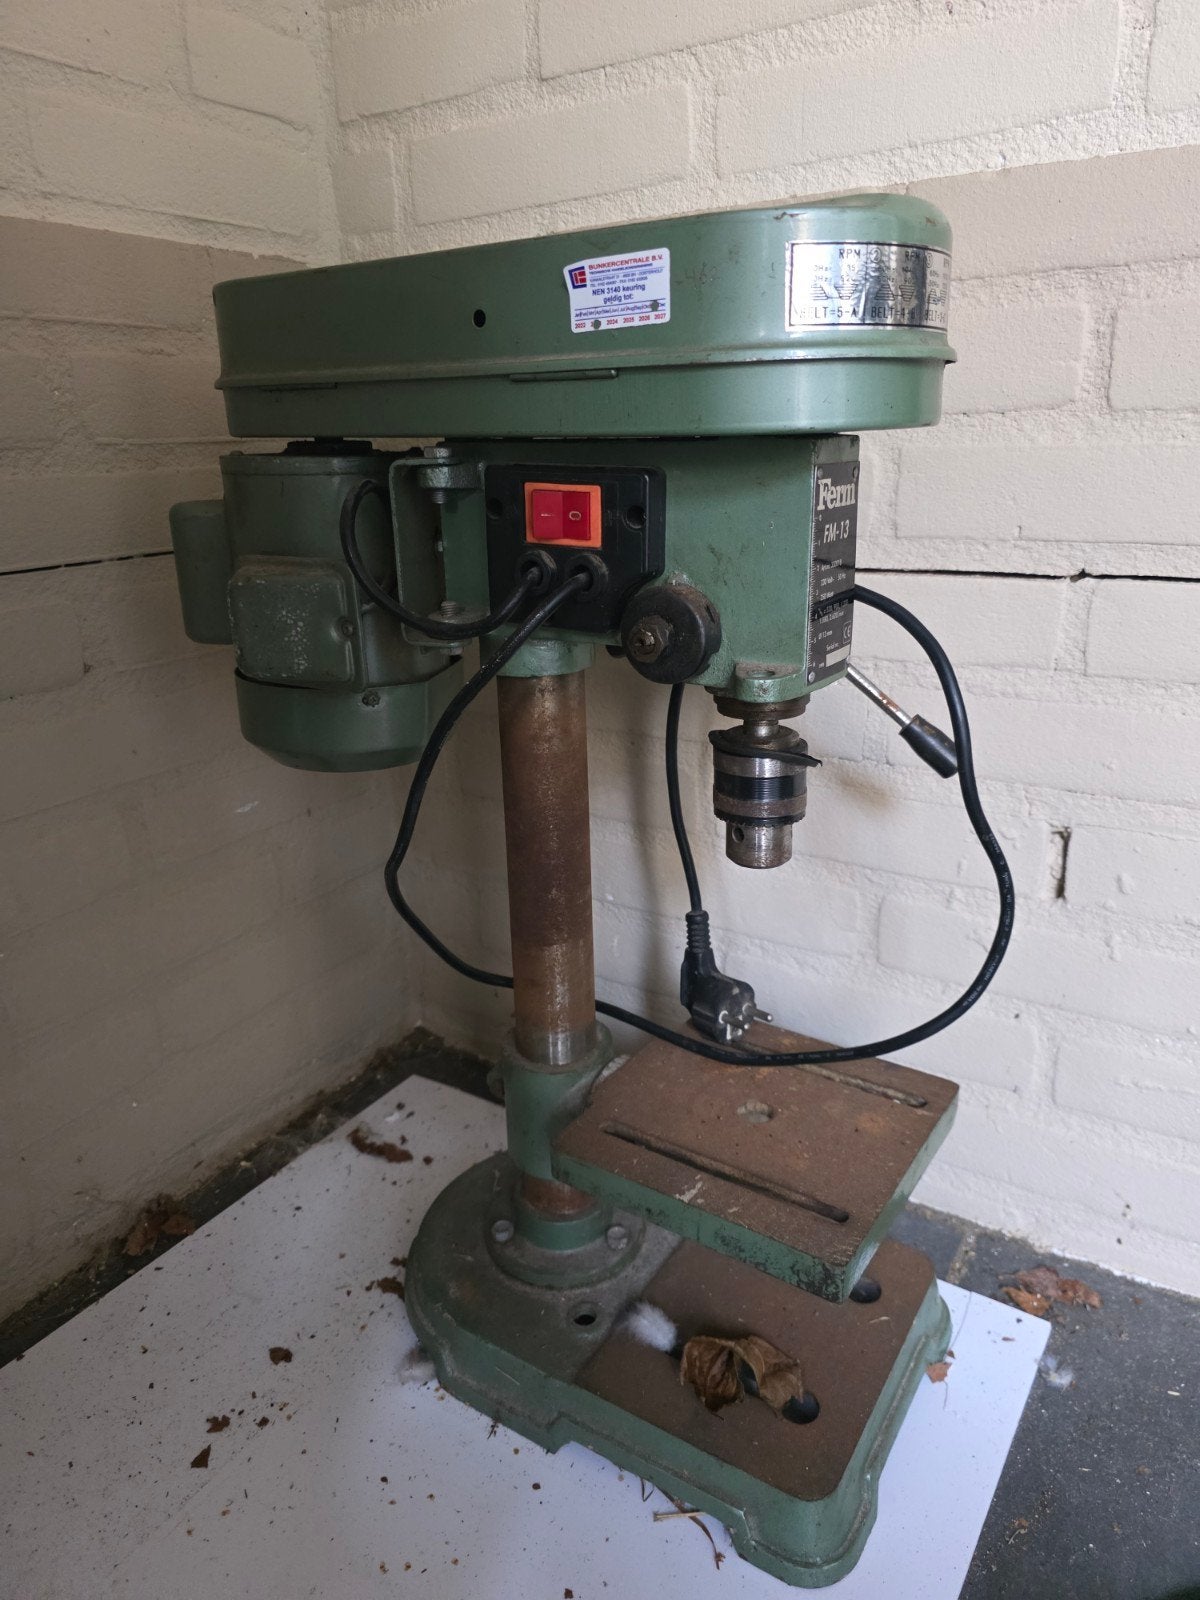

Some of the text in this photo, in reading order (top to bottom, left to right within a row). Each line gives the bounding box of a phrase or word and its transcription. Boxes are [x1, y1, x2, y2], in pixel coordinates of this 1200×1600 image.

[838, 247, 861, 259] RPM
[588, 256, 650, 271] BUNKERCENTRALE
[592, 288, 605, 297] NEN
[606, 286, 621, 295] 3140
[622, 283, 646, 293] keuring
[603, 294, 622, 305] geldig
[817, 478, 856, 512] Ferm
[823, 519, 850, 544] FM-13
